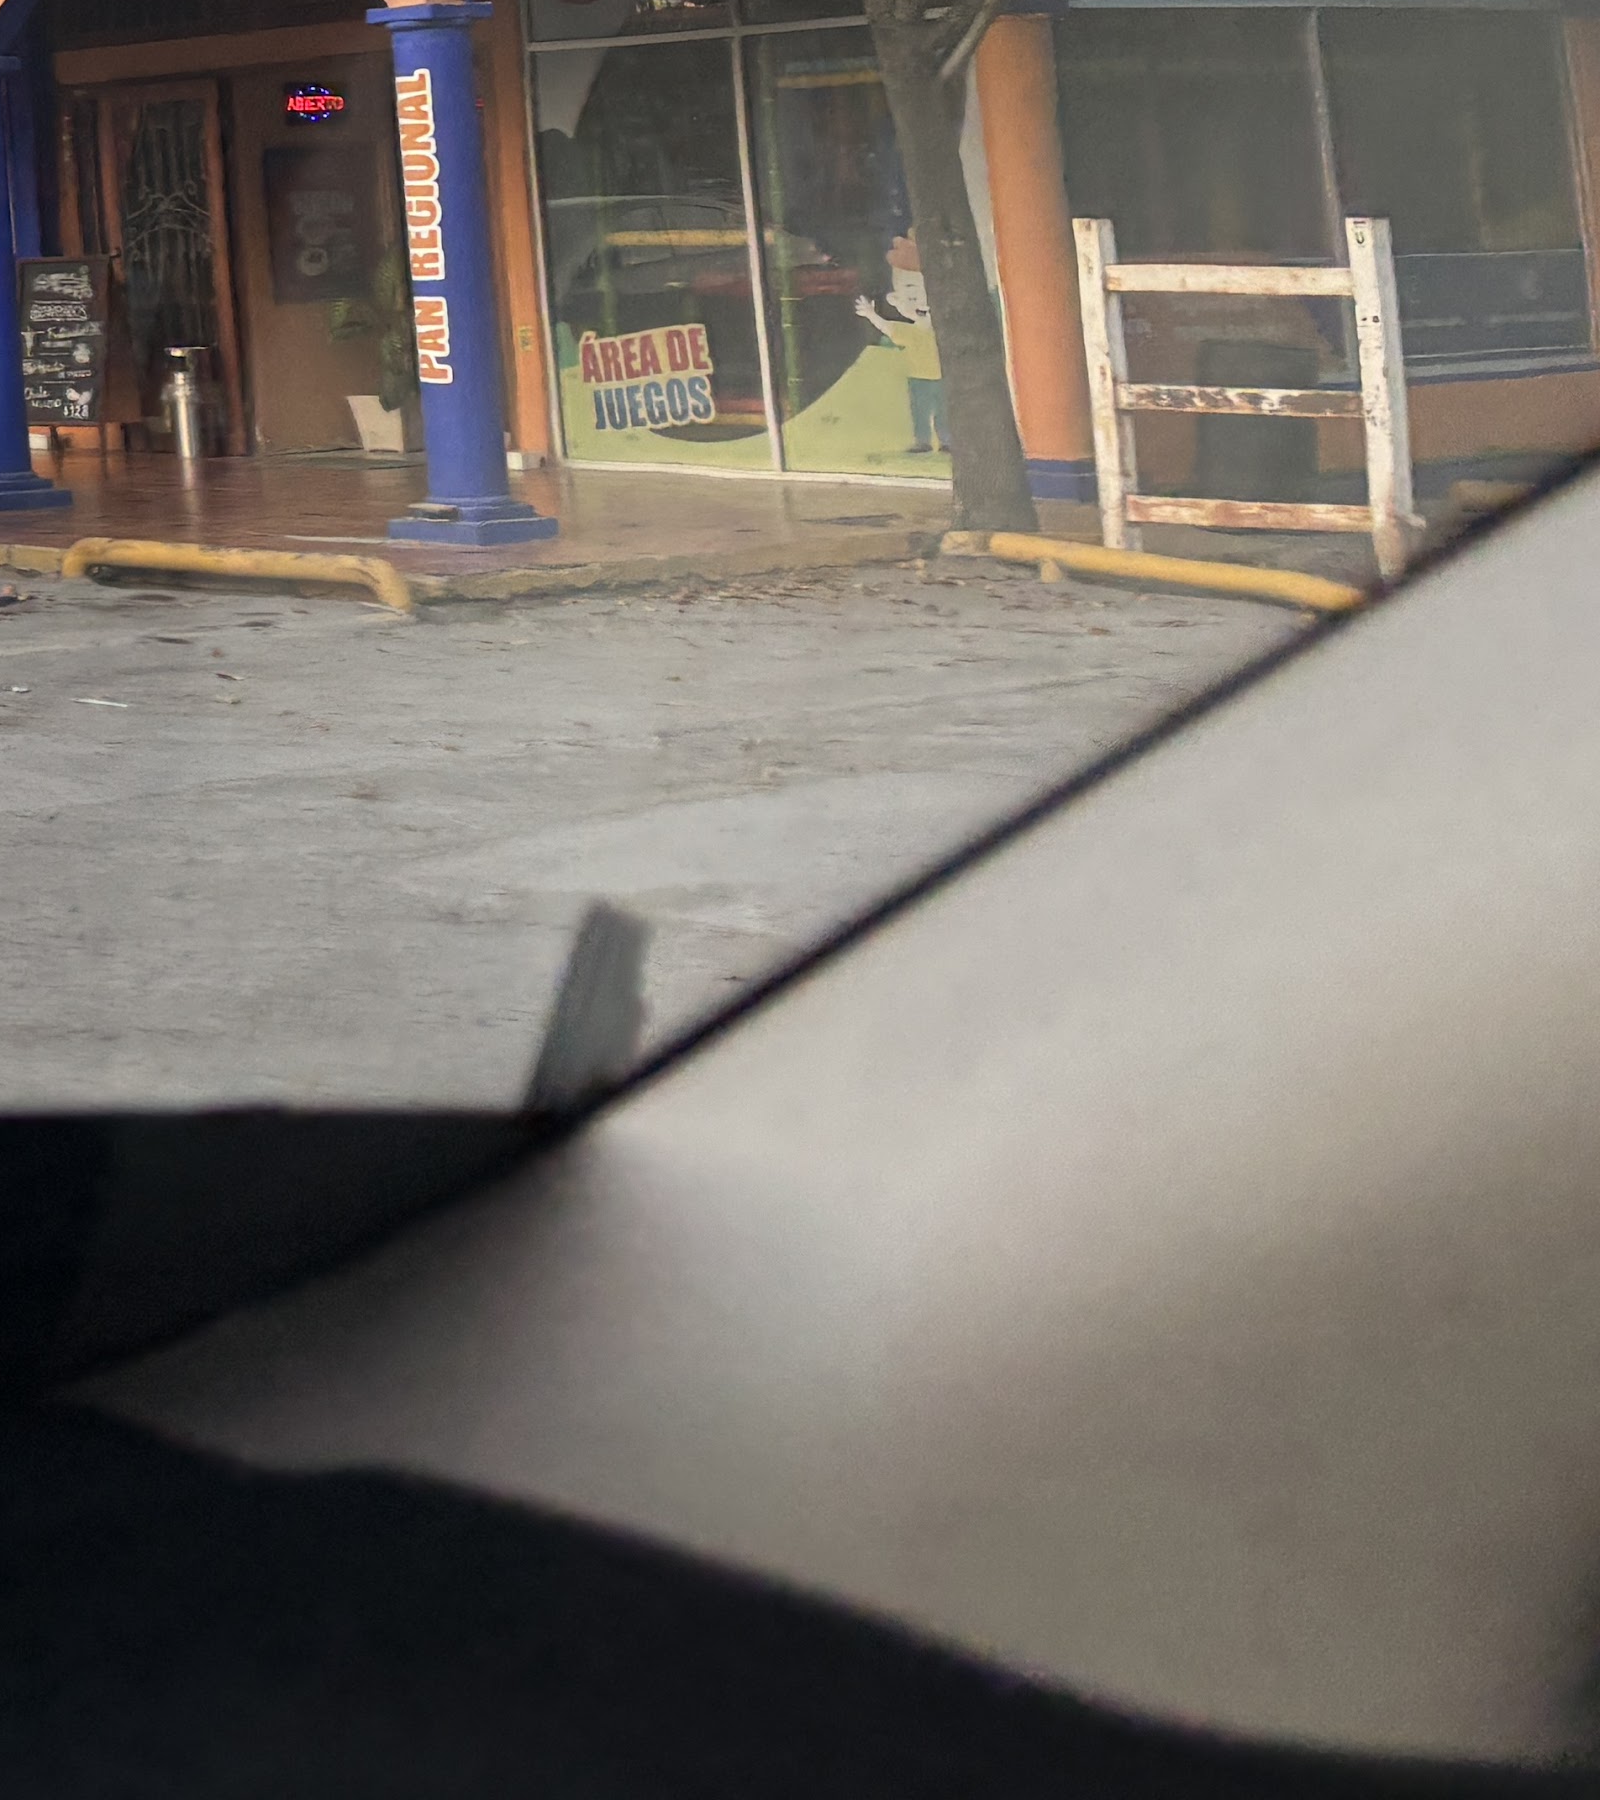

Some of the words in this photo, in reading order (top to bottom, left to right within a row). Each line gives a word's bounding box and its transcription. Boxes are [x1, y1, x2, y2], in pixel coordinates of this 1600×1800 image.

[394, 68, 446, 282] REGIONAL
[413, 296, 454, 384] PAN
[579, 329, 661, 384] ÁREA
[666, 324, 712, 371] DE
[592, 376, 714, 431] JUEGOS
